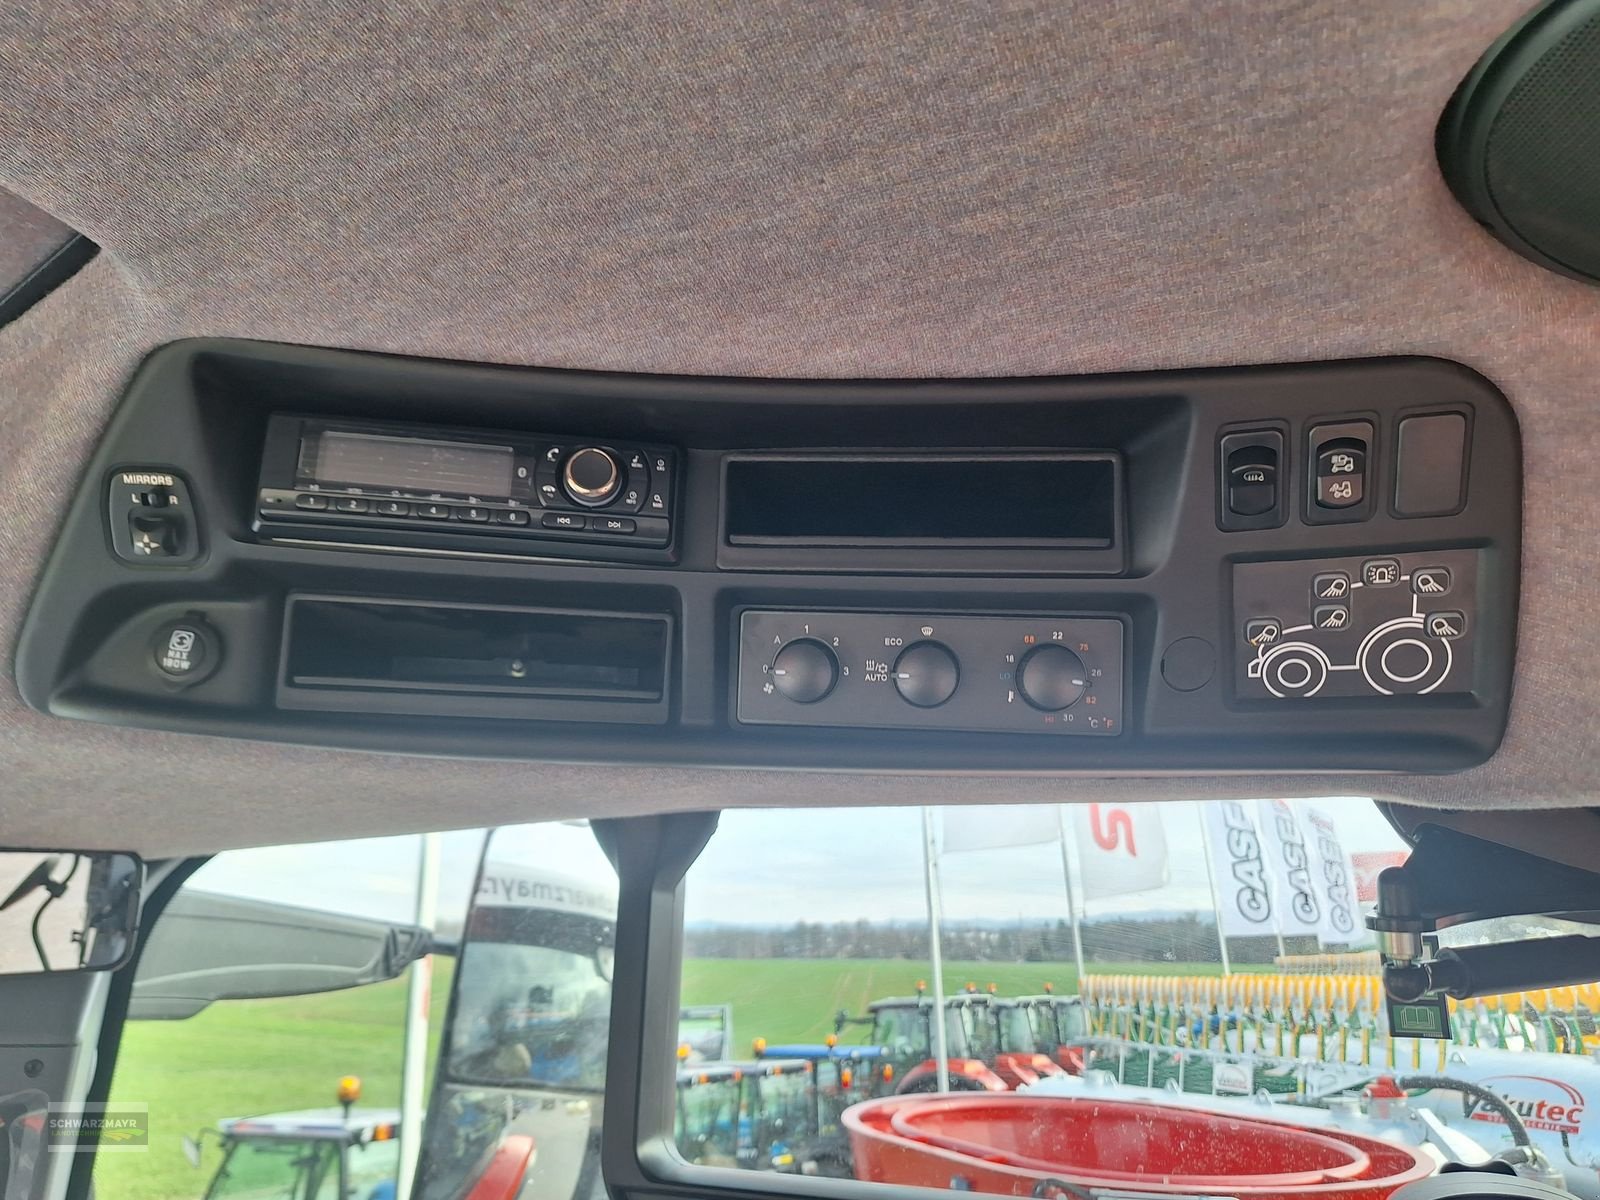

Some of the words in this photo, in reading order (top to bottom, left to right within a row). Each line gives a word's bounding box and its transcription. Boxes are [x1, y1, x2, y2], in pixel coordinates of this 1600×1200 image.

[123, 474, 173, 486] MIRRORS
[131, 493, 140, 503] L
[169, 495, 178, 504] R
[309, 497, 314, 505] 1
[350, 500, 357, 509] 2
[390, 503, 398, 512] 3
[430, 506, 437, 514] 4
[470, 509, 477, 518] 5
[509, 512, 516, 521] 6
[804, 624, 810, 634] 1
[773, 635, 781, 644] A
[1052, 632, 1063, 640] 22
[833, 637, 840, 646] 2
[884, 638, 903, 646] ECO
[1079, 643, 1089, 651] 75
[168, 650, 188, 660] MAX
[1005, 655, 1015, 663] 18
[762, 665, 768, 674] 0
[843, 666, 850, 675] 3
[1091, 669, 1102, 677] 26
[865, 674, 888, 682] AUTO
[1063, 714, 1074, 722] 30
[1222, 801, 1271, 923] CASE
[1275, 815, 1321, 925] CASE
